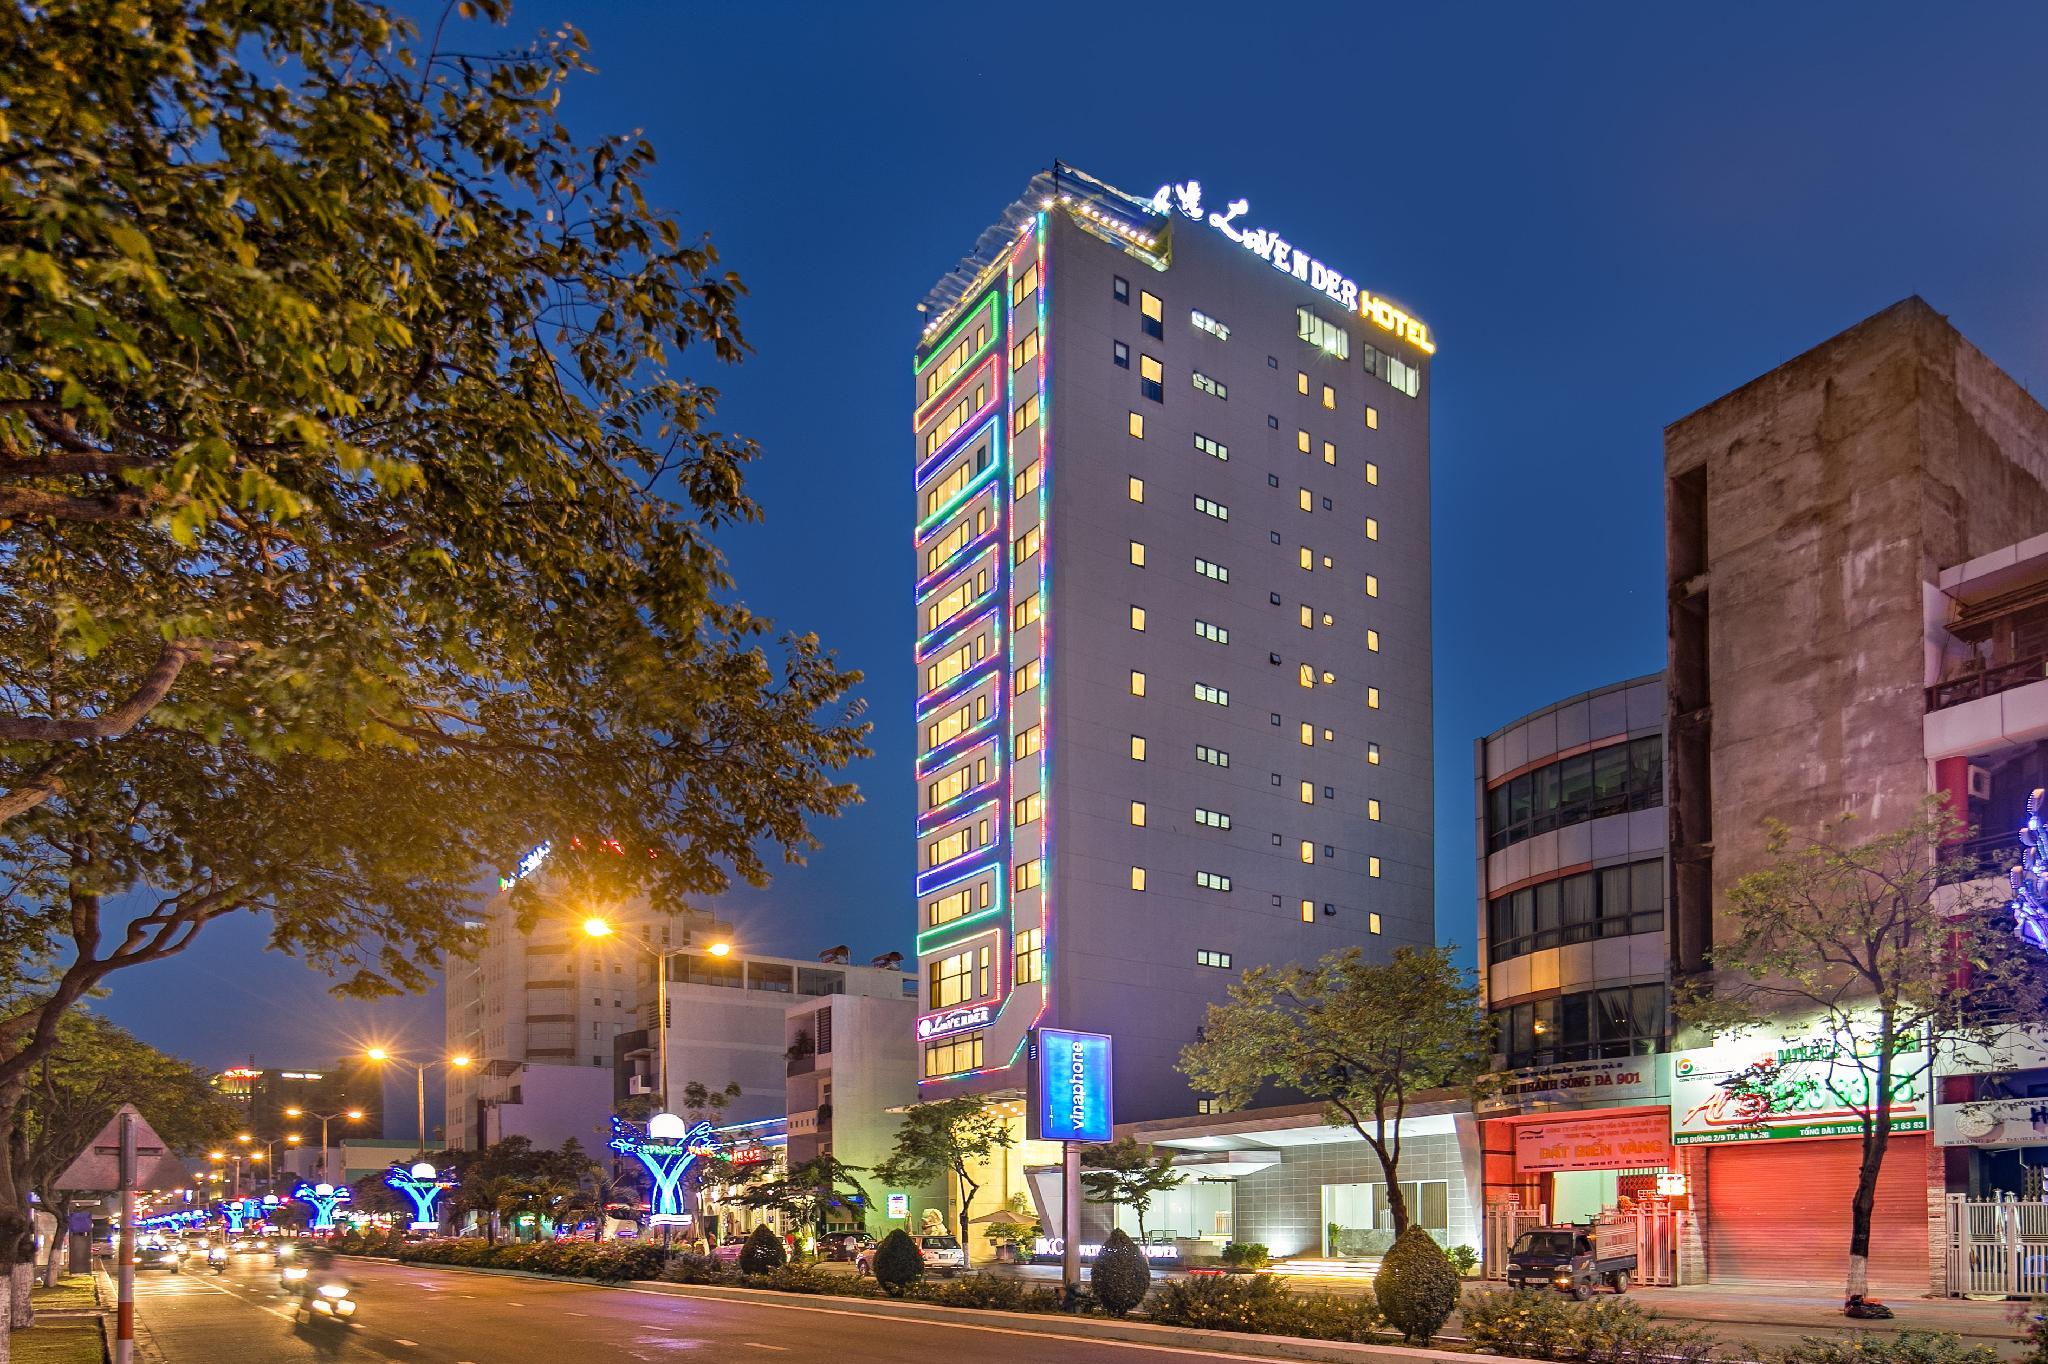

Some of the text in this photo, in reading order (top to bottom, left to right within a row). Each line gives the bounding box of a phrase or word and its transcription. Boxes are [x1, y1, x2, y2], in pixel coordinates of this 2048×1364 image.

[1360, 289, 1437, 354] HOTEL
[1068, 1041, 1086, 1130] vinaphone
[1520, 1078, 1558, 1093] NHÁNH
[1560, 1074, 1591, 1089] SÔNG
[1594, 1071, 1613, 1086] ĐÀ
[1616, 1072, 1641, 1085] 901
[1799, 1126, 1819, 1136] TỔNG
[1617, 1138, 1663, 1154] VÀNG
